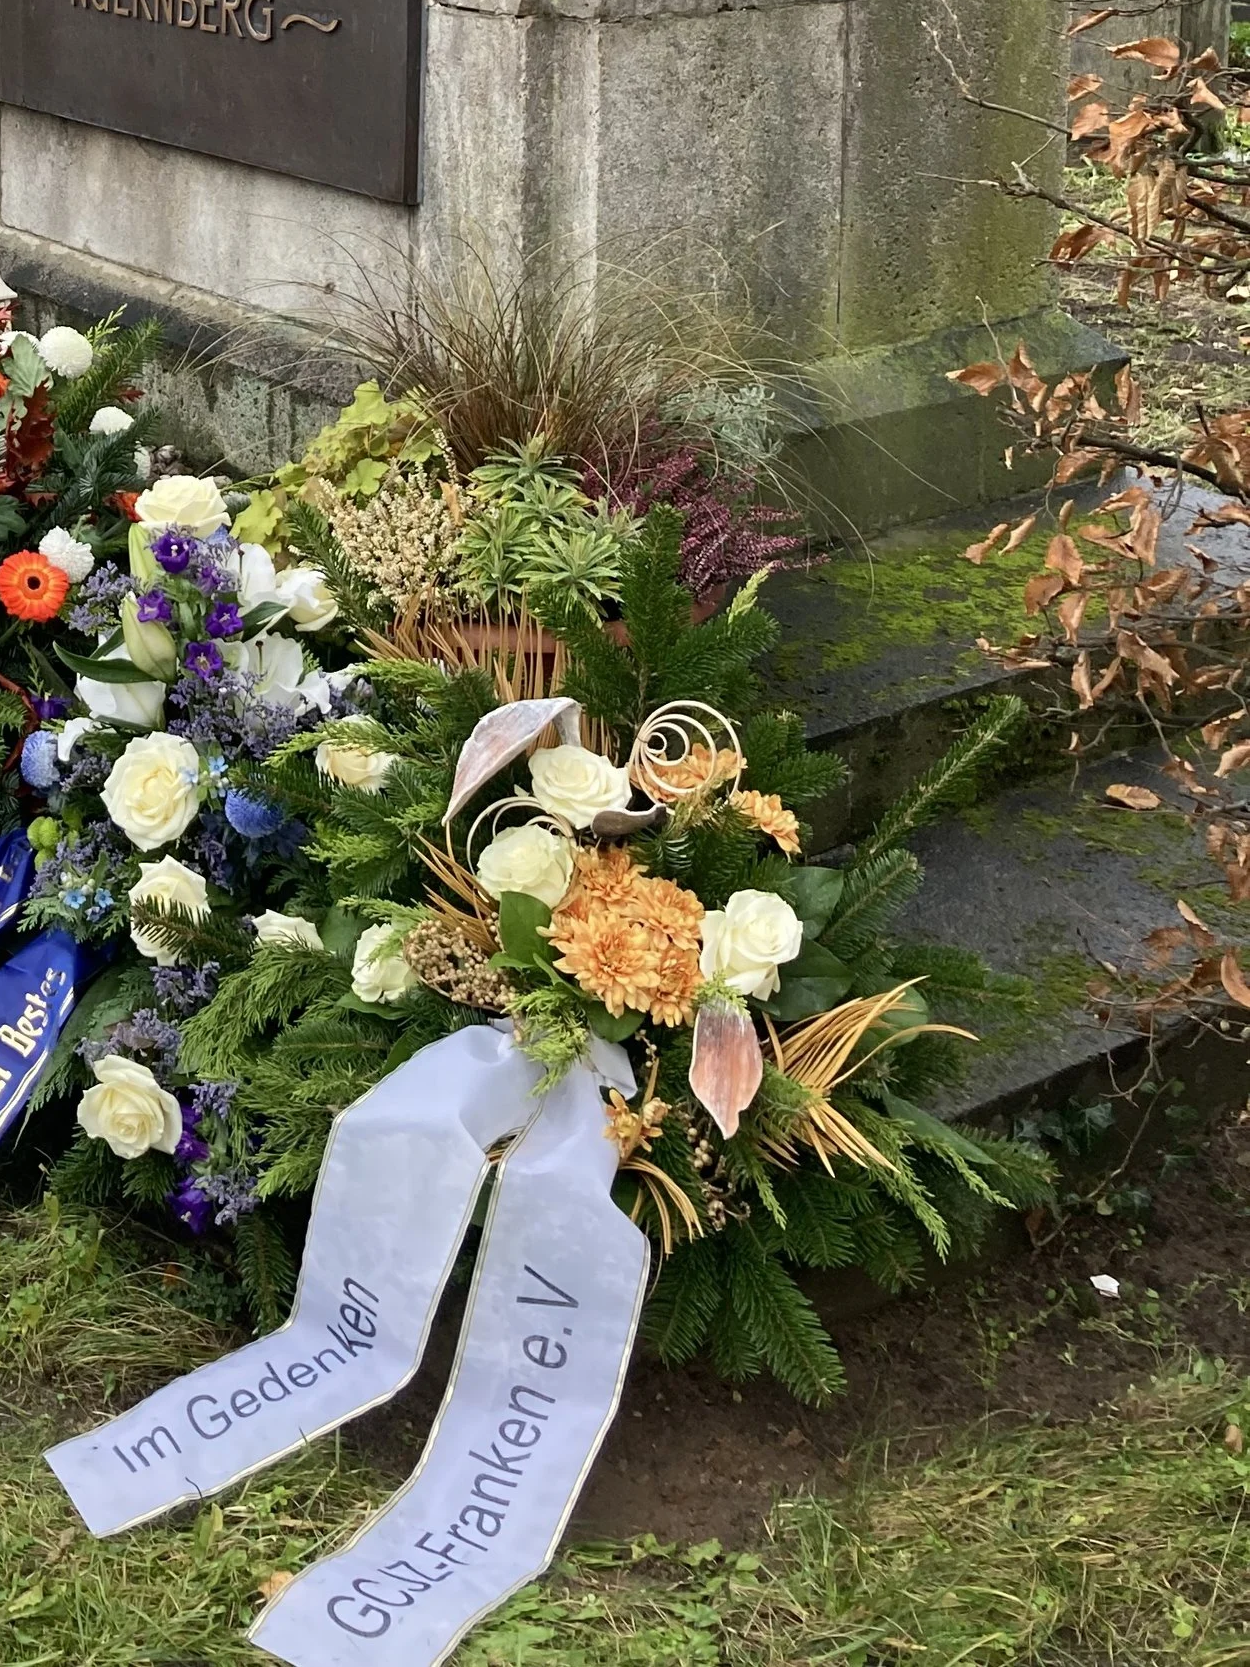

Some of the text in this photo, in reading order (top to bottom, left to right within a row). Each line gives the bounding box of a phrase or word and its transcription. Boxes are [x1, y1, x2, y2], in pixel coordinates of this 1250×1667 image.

[111, 1276, 381, 1474] Im Gedenken
[327, 1383, 557, 1639] GCJZ-Franken
